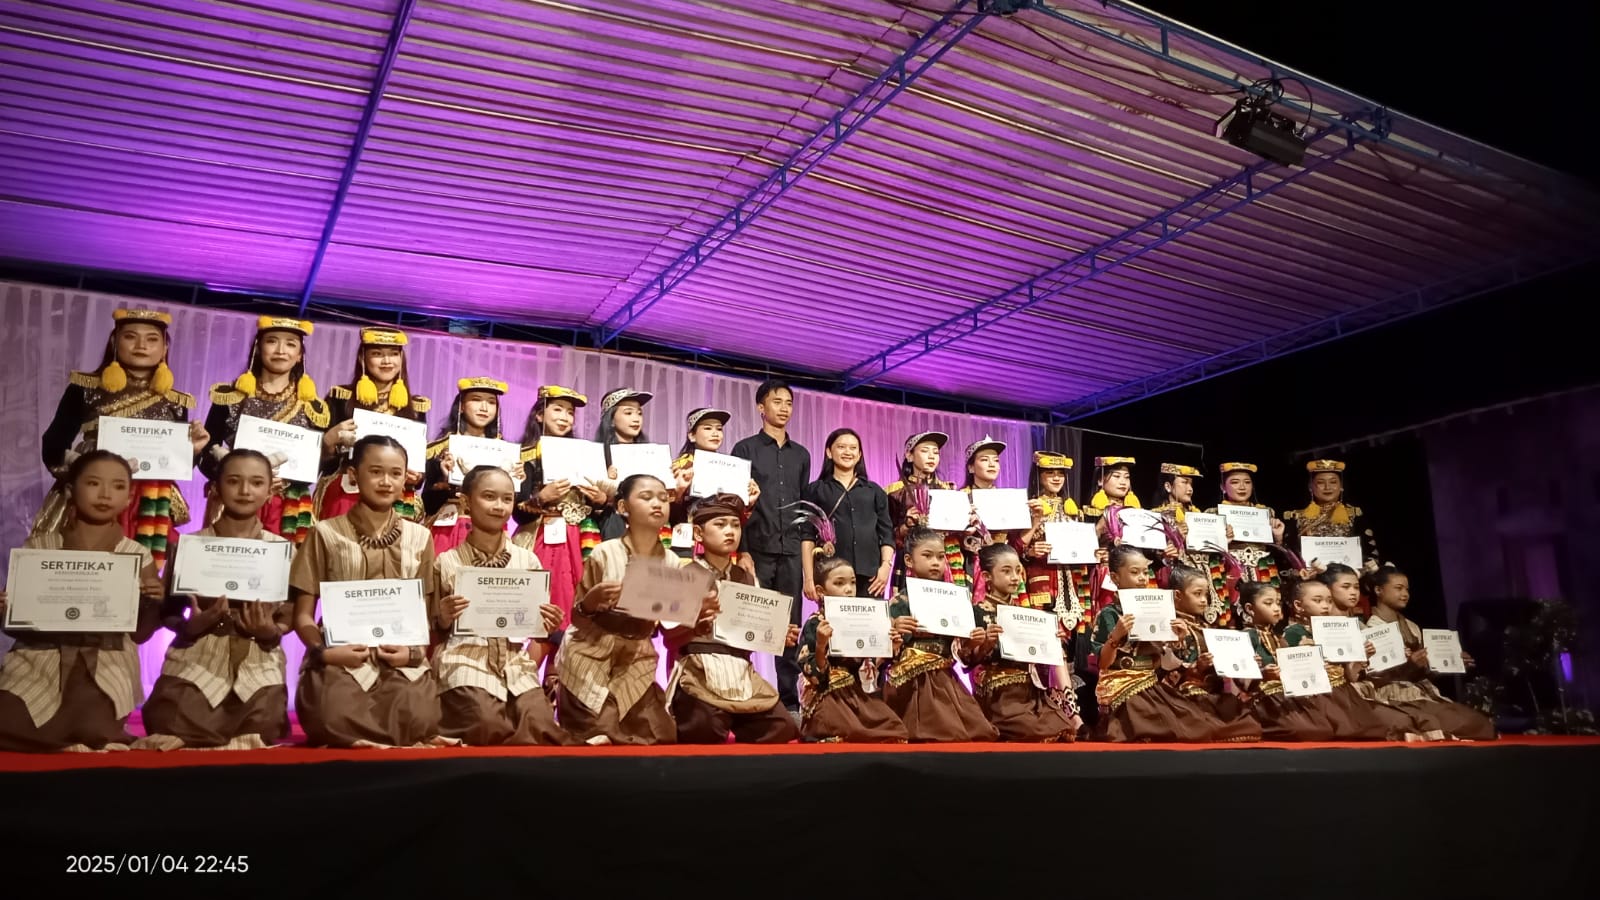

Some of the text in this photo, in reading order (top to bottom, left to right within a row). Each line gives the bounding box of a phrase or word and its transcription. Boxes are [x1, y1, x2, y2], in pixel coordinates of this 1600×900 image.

[120, 426, 174, 436] SERTIFIKAT
[258, 426, 305, 441] SERTIFIKAT
[204, 544, 268, 556] SERTIFIKAT
[41, 560, 114, 571] SERTIFIKAT
[477, 577, 531, 586] SERTIFIKAT
[344, 587, 402, 599] SERTIFIKAT
[735, 592, 780, 608] SERTIFIKAT
[839, 604, 876, 613] SERTIFIKAT
[1012, 613, 1047, 624] SERTIFIKAT
